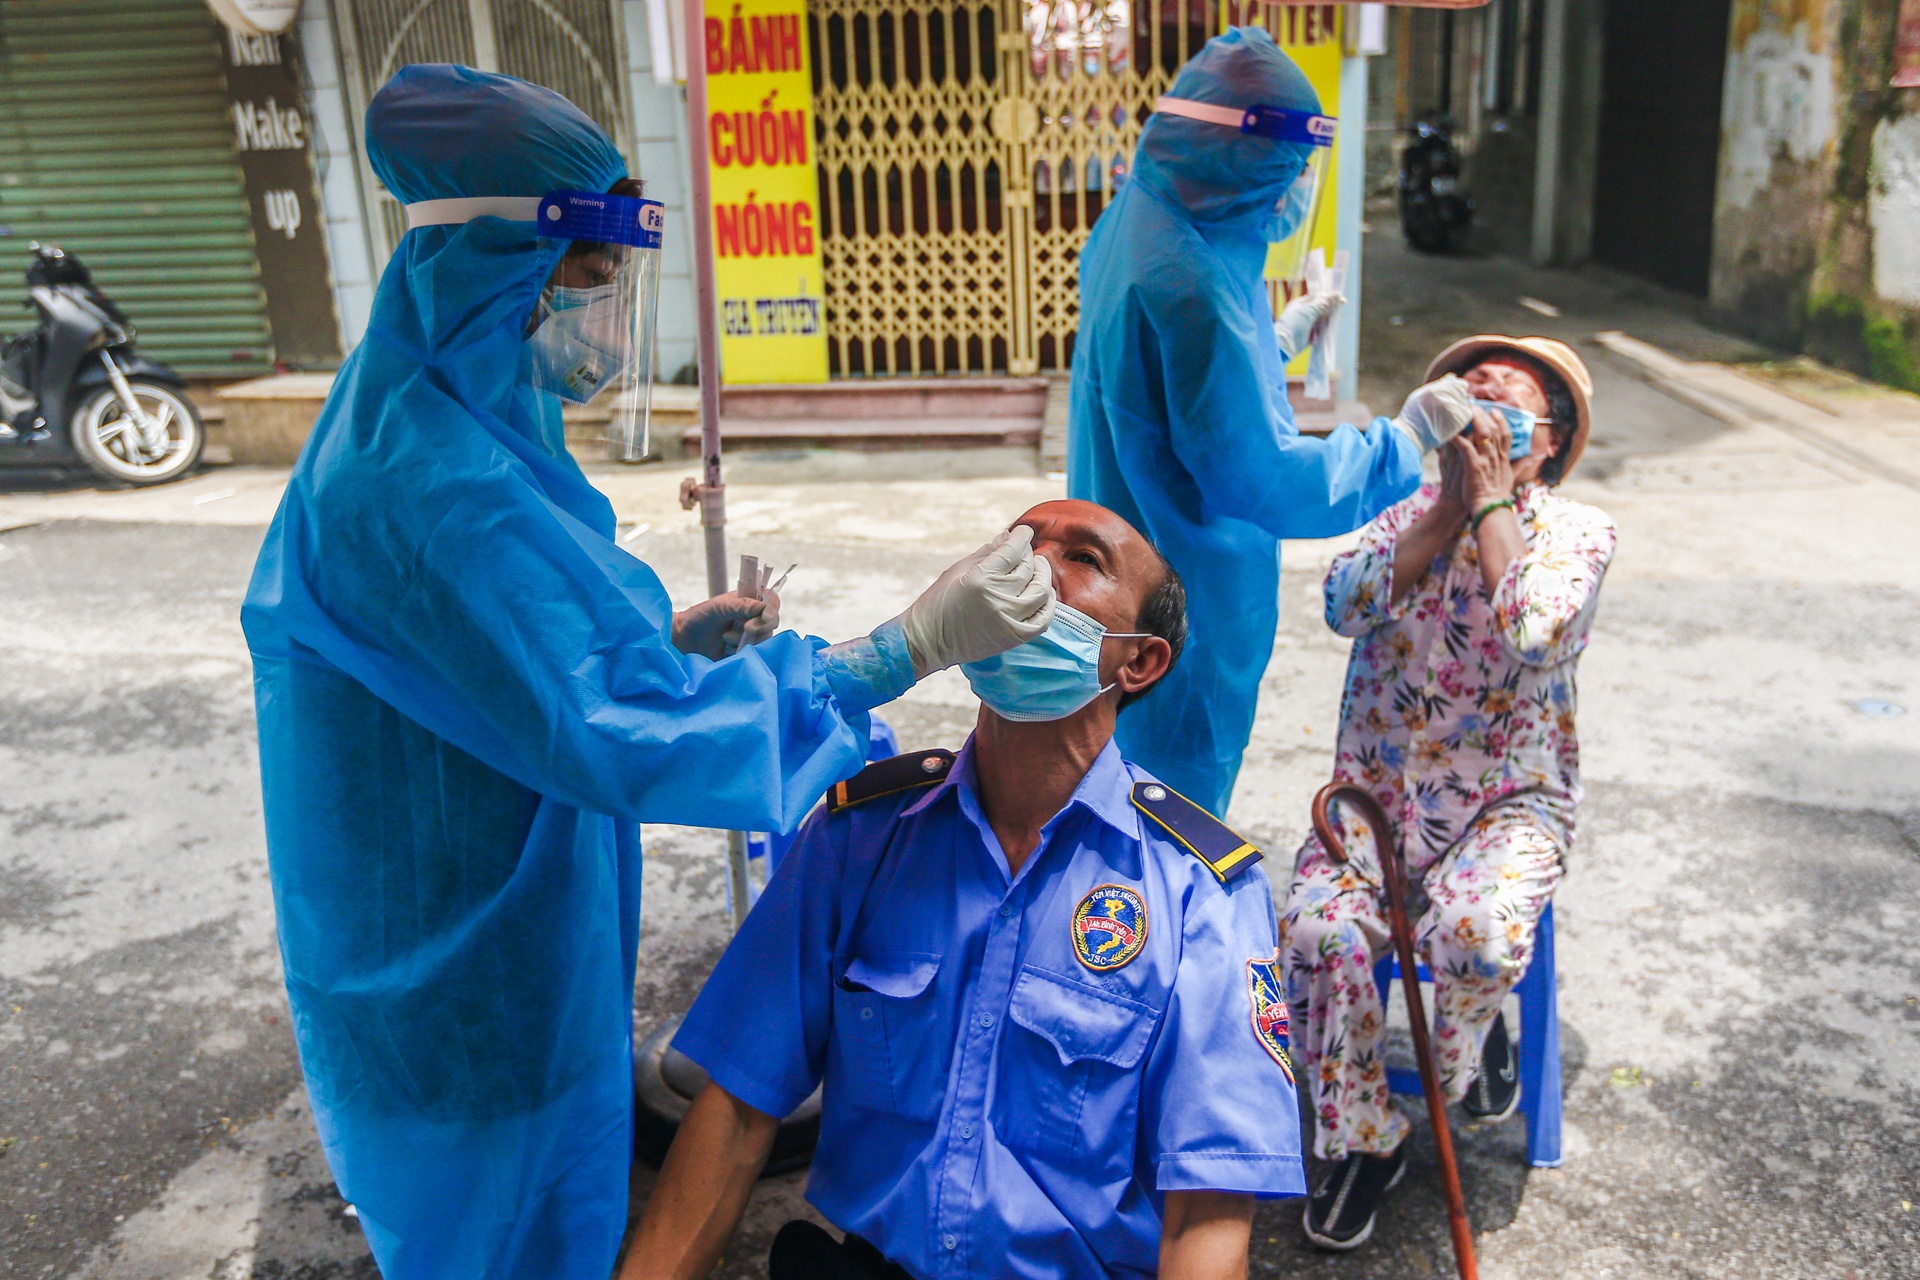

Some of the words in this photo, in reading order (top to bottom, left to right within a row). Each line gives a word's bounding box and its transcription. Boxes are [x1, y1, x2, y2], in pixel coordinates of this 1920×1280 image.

[704, 3, 802, 75] BÁNH
[233, 97, 304, 150] Make
[710, 89, 807, 168] CUỐN
[264, 190, 302, 240] up
[715, 191, 815, 258] NÓNG
[1088, 953, 1107, 965] JSC
